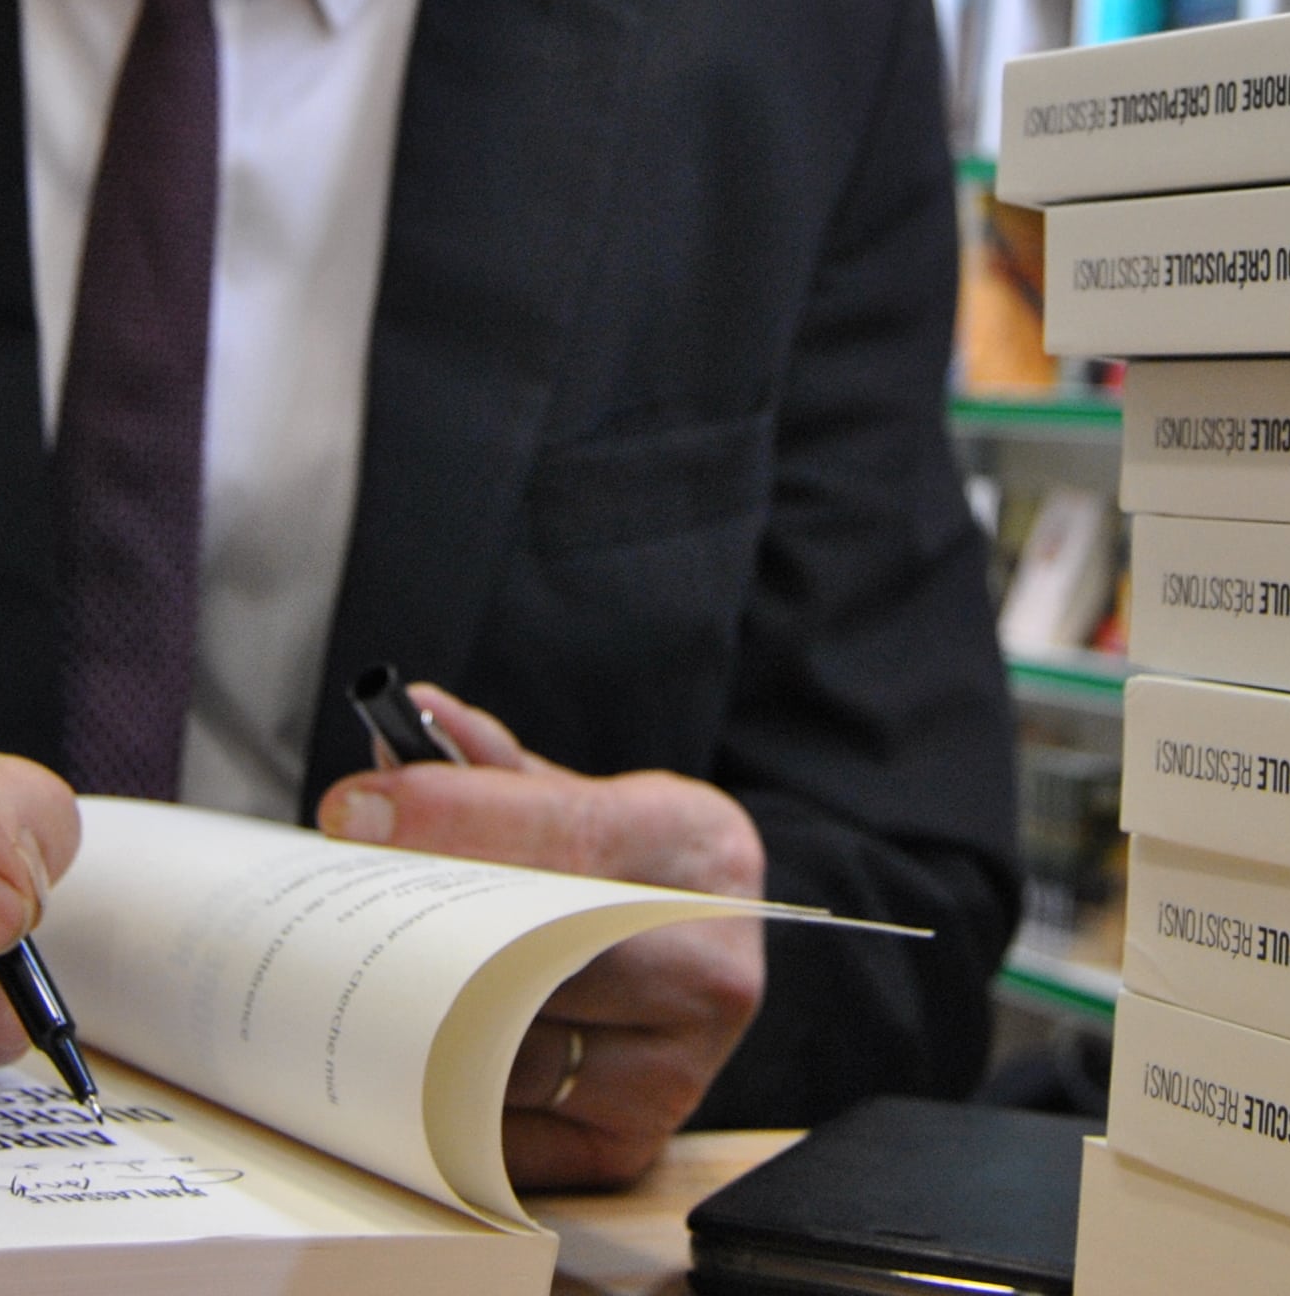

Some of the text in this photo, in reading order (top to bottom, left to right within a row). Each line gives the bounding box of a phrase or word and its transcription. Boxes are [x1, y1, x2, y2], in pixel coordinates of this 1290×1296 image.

[1024, 98, 1106, 138] RÉSISTONS!
[1109, 84, 1210, 128] CRÉPUSCULE
[1214, 80, 1237, 115] OU
[1073, 254, 1160, 294] RÉSISTONS!
[1163, 248, 1271, 290] CRÉPUSCULE
[1155, 416, 1245, 457] RÉSISTONS!
[1162, 572, 1255, 619] RÉSISTONS!
[1155, 739, 1252, 792] RÉSISTONS!
[1157, 901, 1253, 960] RÉSISTONS!
[239, 937, 284, 1043] Différence
[325, 967, 365, 1060] cherche
[325, 1059, 341, 1106] midi
[1143, 1061, 1239, 1128] RÉSISTONS!
[101, 1107, 175, 1123] OU
